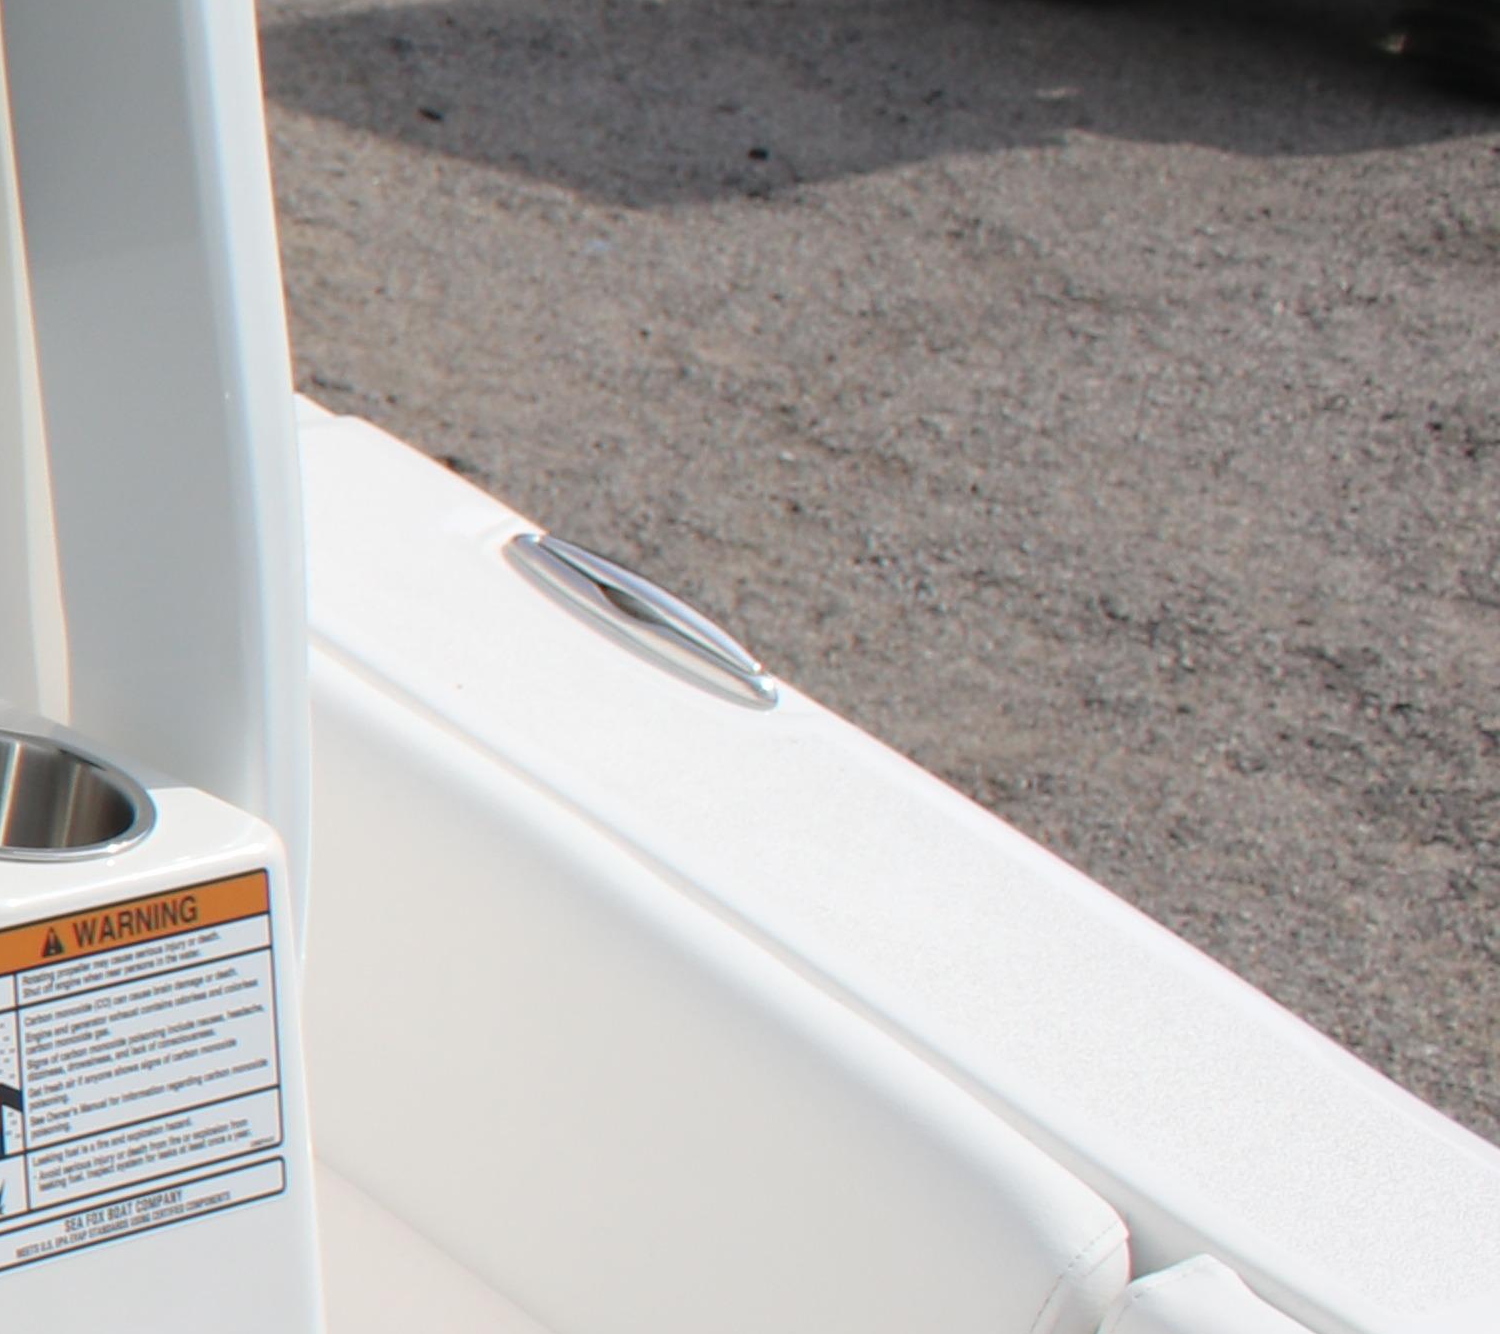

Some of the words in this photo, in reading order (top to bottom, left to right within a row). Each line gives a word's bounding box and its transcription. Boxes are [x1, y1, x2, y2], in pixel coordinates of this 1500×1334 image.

[73, 895, 198, 949] WARNING
[64, 1215, 83, 1233] SEA
[84, 1209, 105, 1227] FOX
[106, 1201, 133, 1221] BOAT
[134, 1188, 182, 1213] COMPANY
